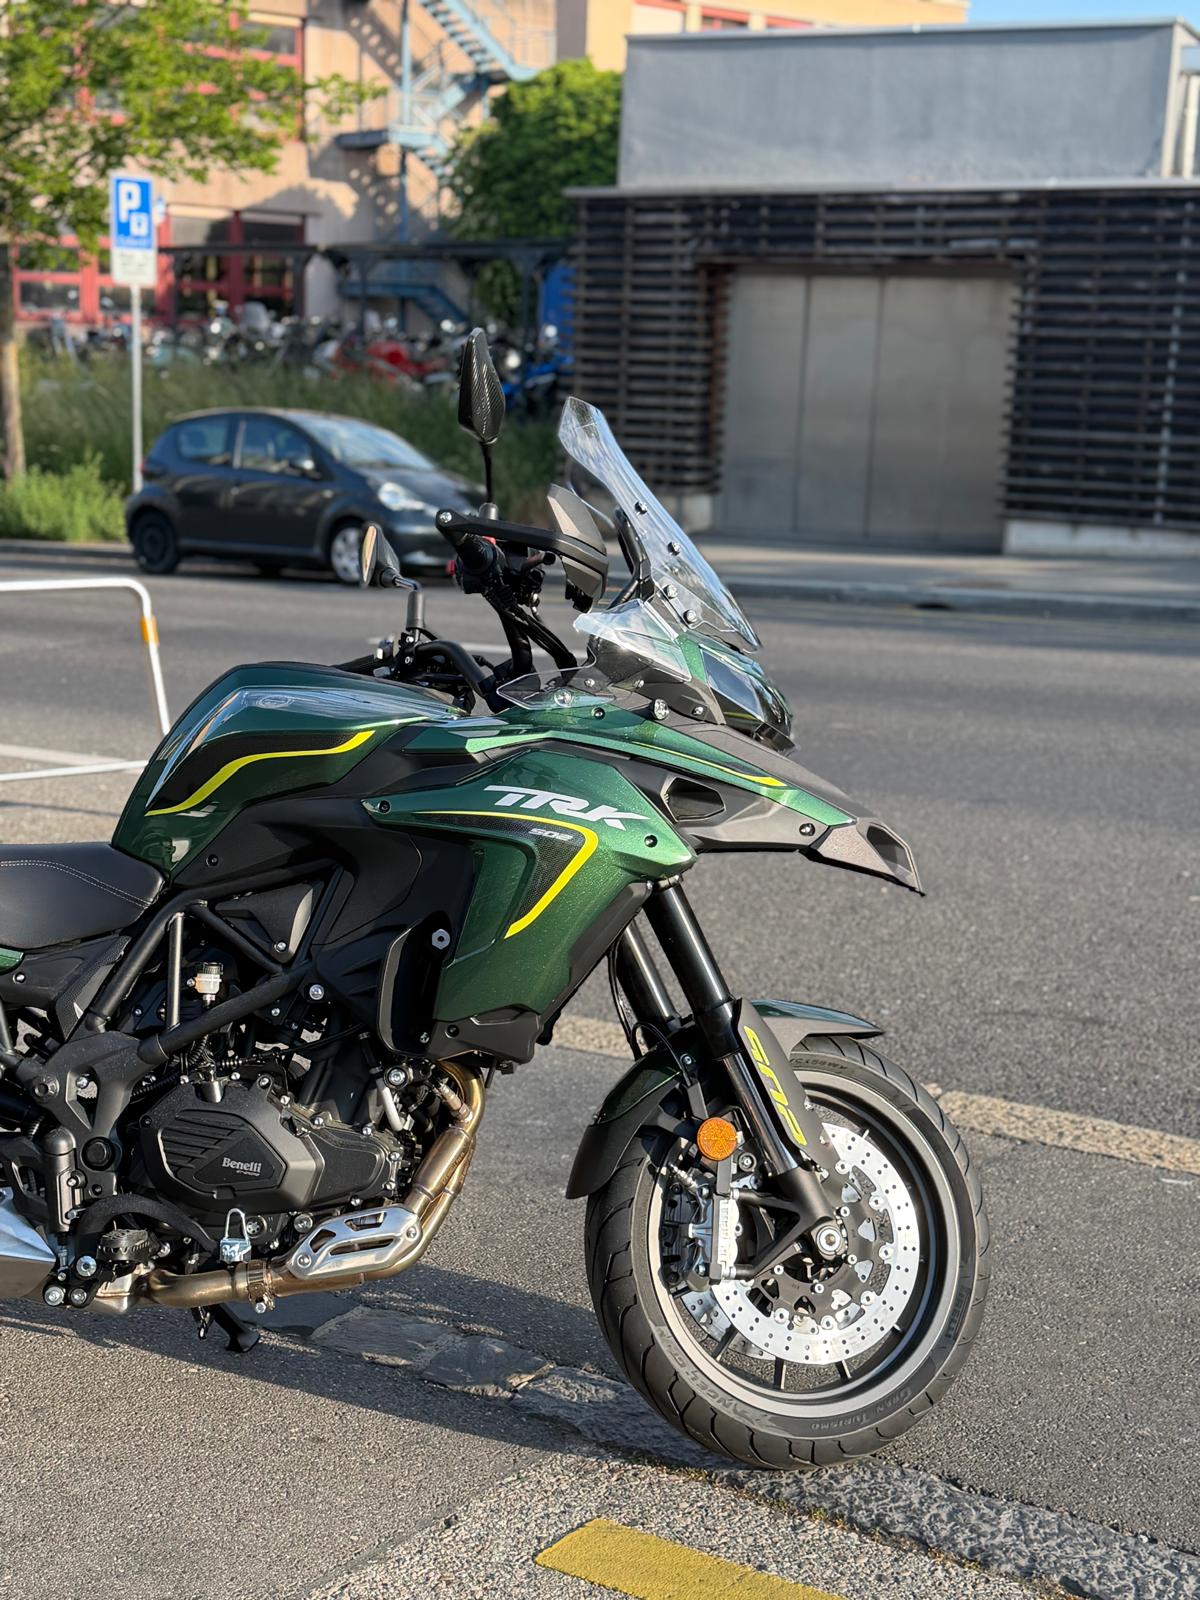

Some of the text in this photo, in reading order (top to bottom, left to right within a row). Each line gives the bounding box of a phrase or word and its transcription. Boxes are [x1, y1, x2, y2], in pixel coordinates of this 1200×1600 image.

[119, 181, 141, 223] P
[484, 785, 651, 831] TRK
[528, 827, 573, 842] 502
[222, 1157, 262, 1172] Benelli
